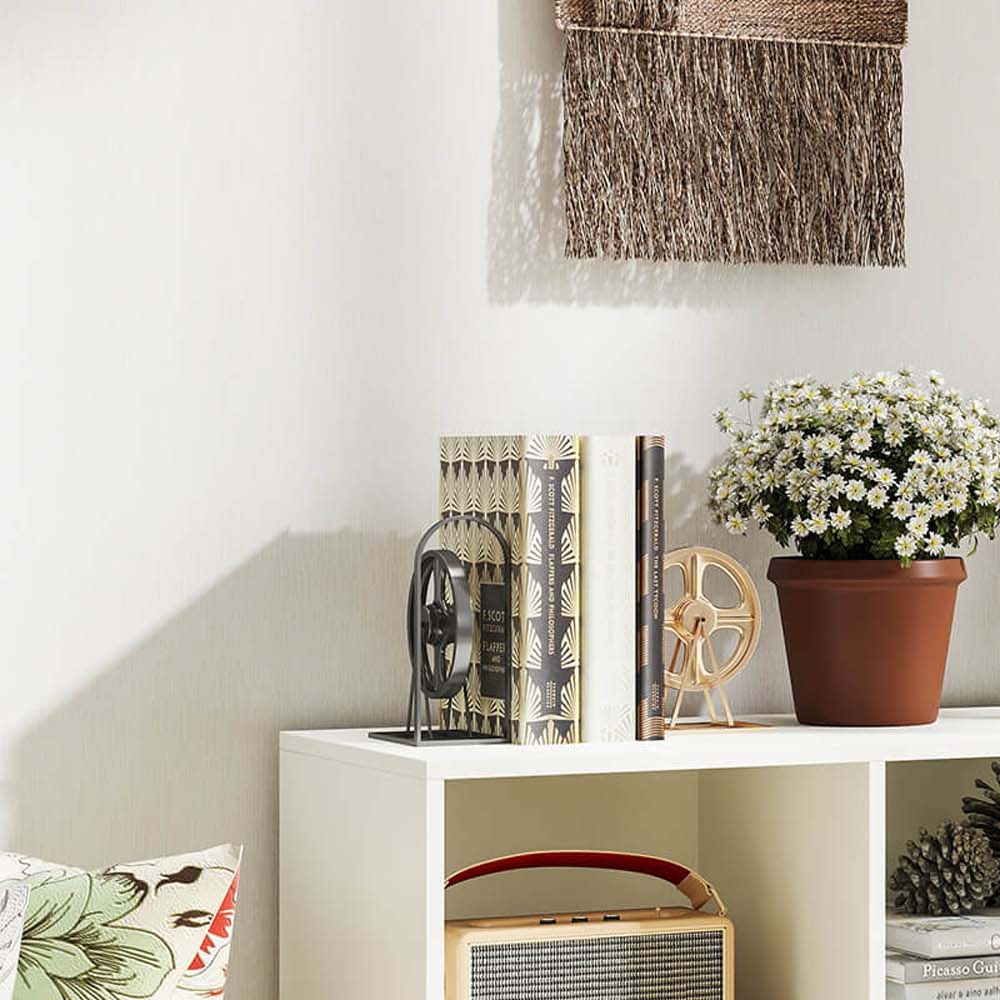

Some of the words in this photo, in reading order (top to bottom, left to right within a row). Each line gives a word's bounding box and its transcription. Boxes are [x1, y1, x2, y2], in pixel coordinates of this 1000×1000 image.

[922, 963, 970, 977] Picasso
[936, 990, 956, 1000] alvar
[966, 988, 982, 998] aino
